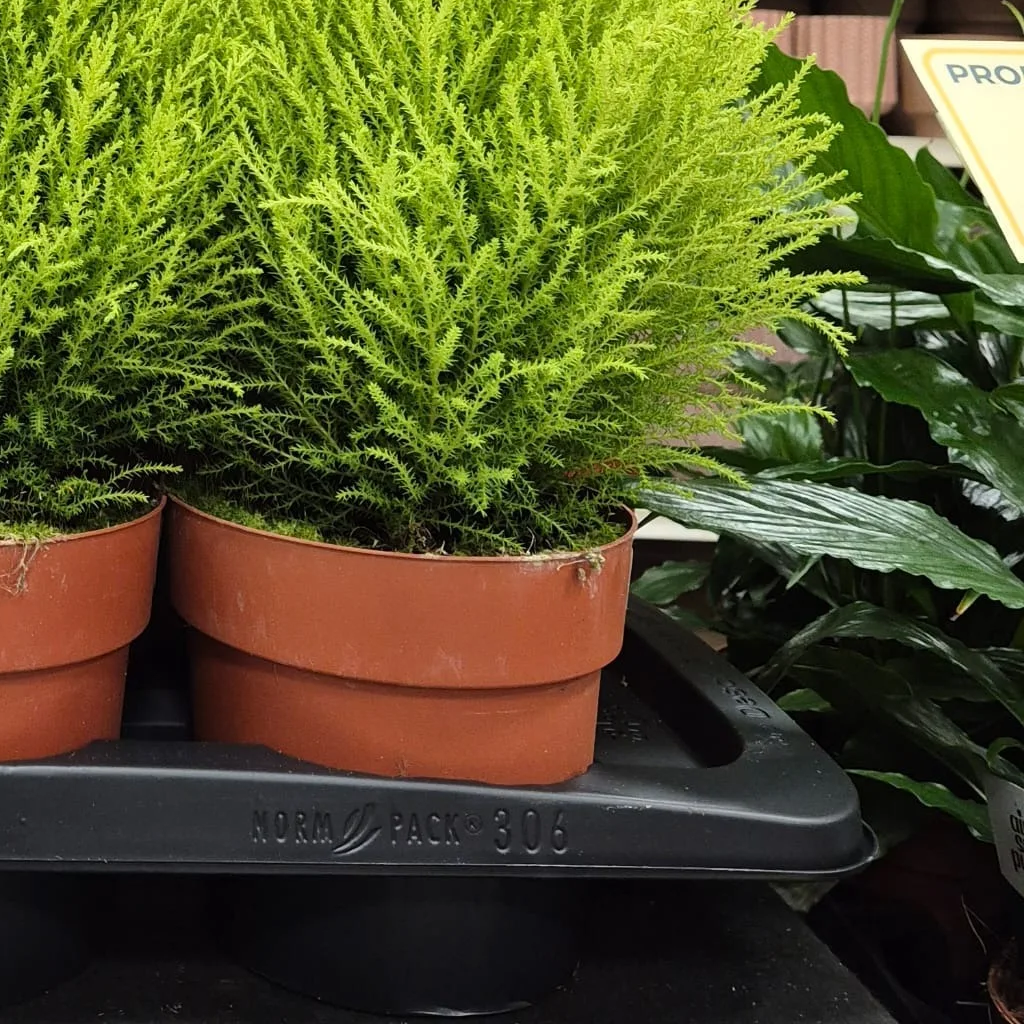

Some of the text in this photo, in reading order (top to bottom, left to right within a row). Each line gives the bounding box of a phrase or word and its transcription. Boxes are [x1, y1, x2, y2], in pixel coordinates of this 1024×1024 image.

[945, 63, 1024, 85] PRO
[252, 810, 333, 844] NORM
[494, 808, 569, 855] 306
